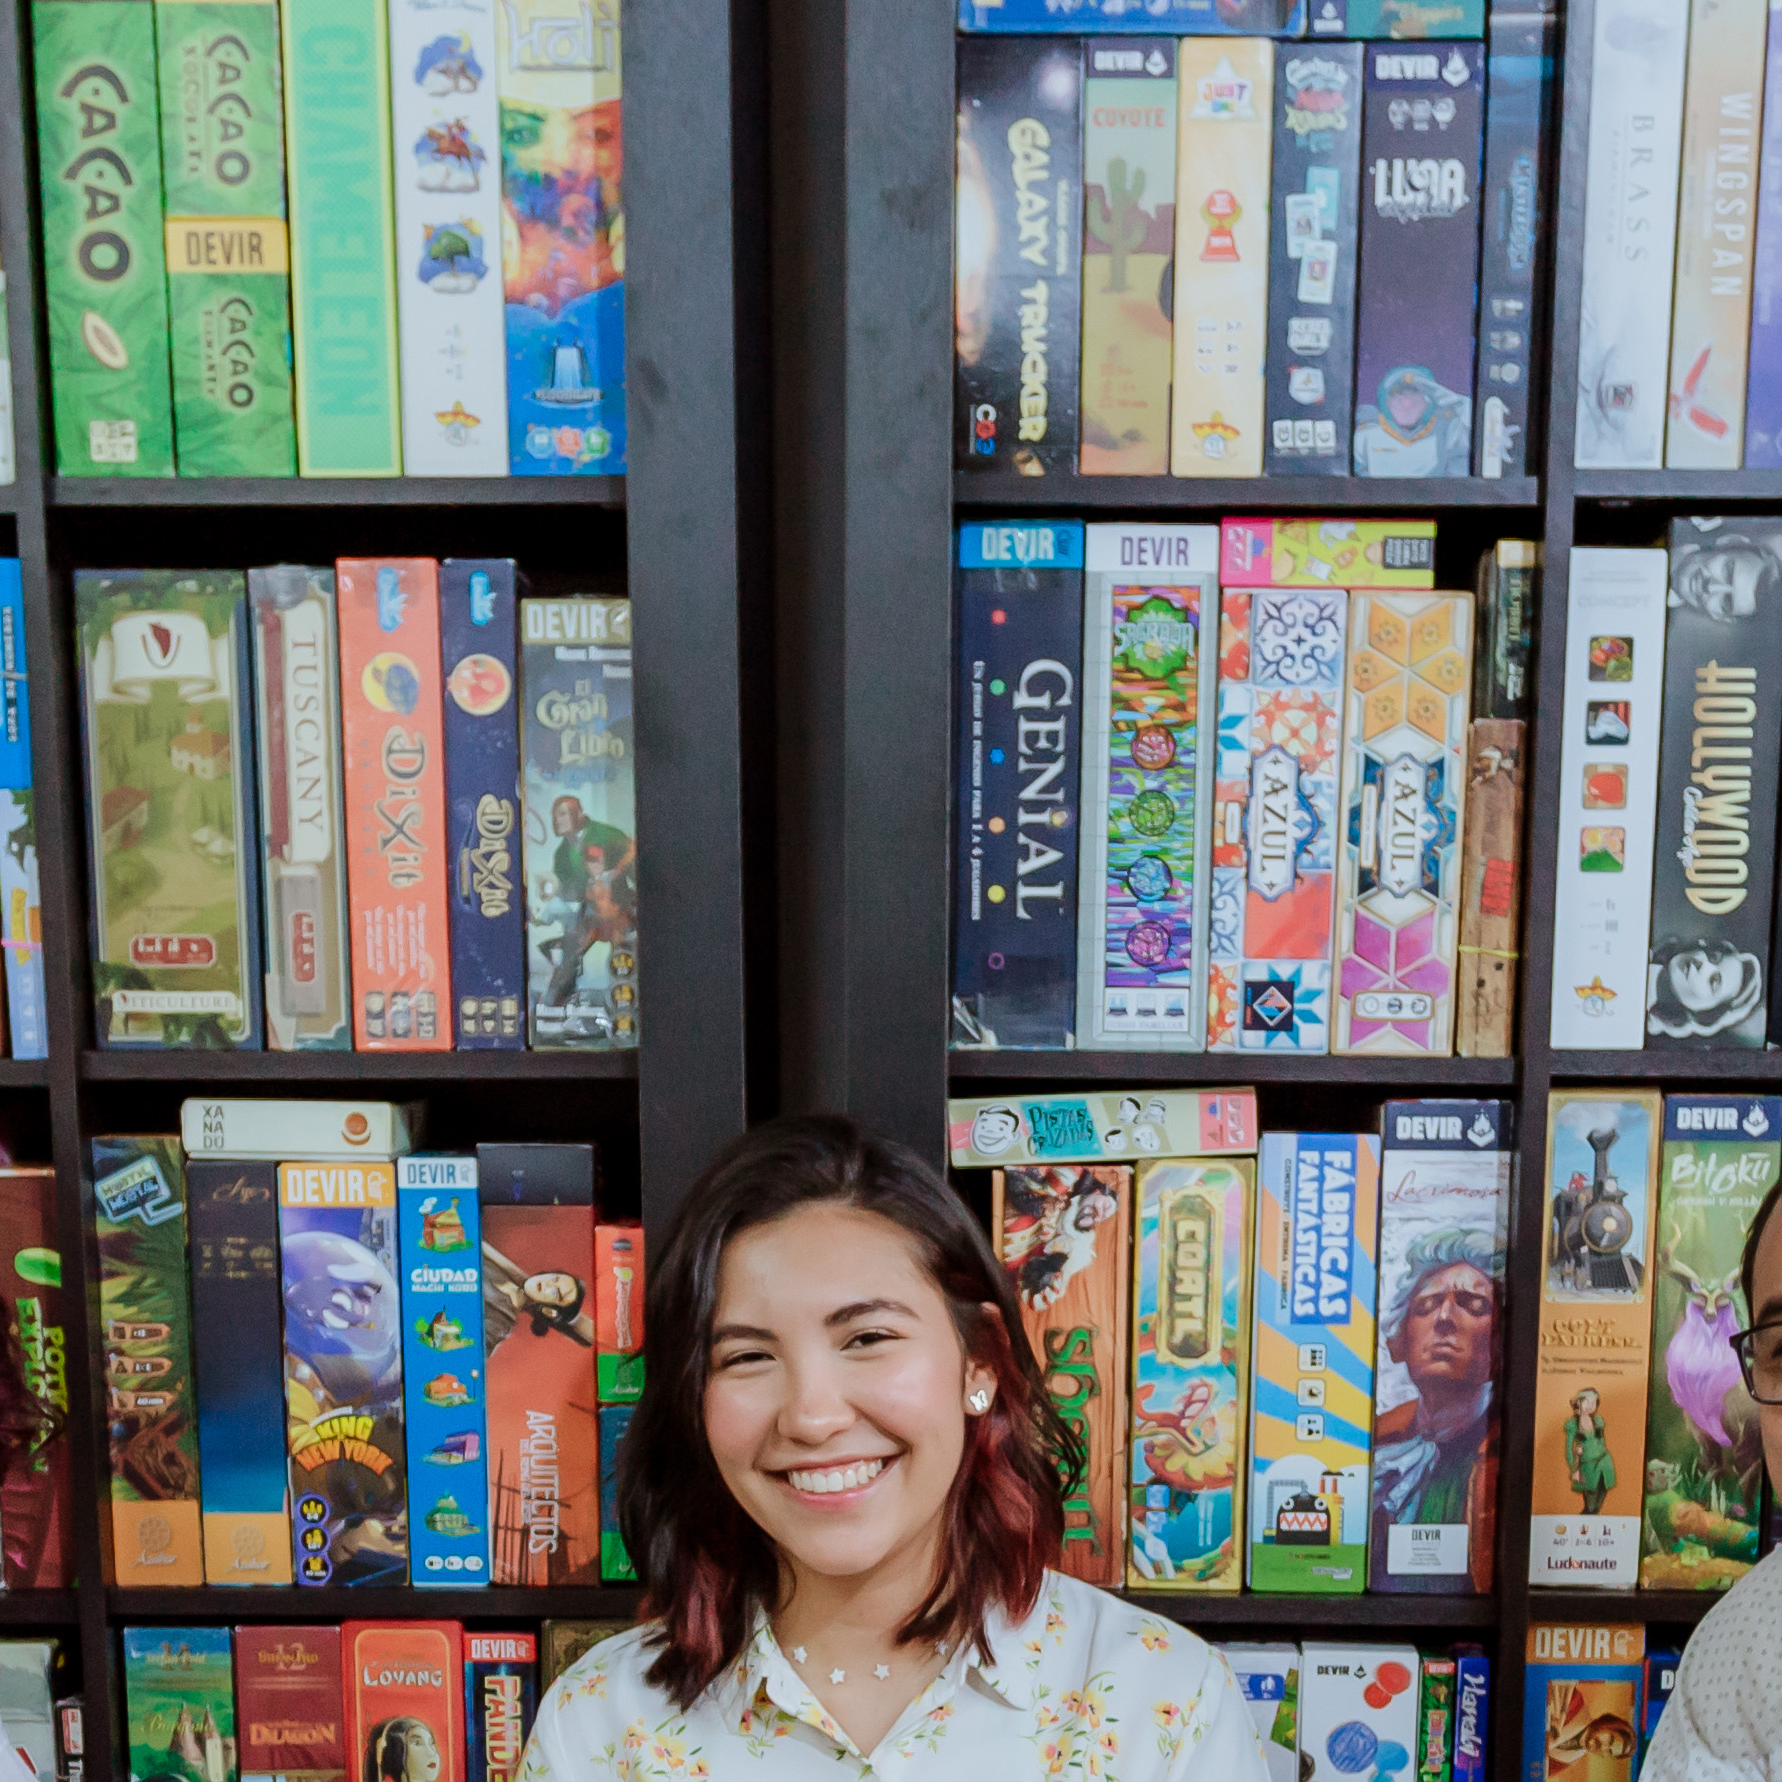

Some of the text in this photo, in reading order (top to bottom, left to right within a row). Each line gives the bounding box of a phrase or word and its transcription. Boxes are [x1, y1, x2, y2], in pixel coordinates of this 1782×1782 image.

[1375, 54, 1439, 80] DEVIR
[206, 34, 252, 186] CACAO
[1092, 107, 1166, 127] COYOTE
[60, 64, 133, 283] CACAO
[1624, 113, 1655, 263] BRASS
[1710, 92, 1754, 297] WINGSPAN
[186, 231, 264, 267] DEVIR
[1007, 117, 1052, 443] GALAXY TRUCKER
[221, 297, 256, 409] CACAO
[982, 528, 1055, 561] DEVIR
[1121, 537, 1189, 566] DEVIR
[527, 604, 605, 640] DEVIR
[291, 634, 325, 834] TUSCANY
[1684, 659, 1758, 916] HOLLYWOOD
[1261, 772, 1289, 874] AZUL
[1390, 778, 1419, 873] AZUL
[202, 1105, 225, 1119] XA
[202, 1120, 225, 1134] NA
[1028, 1106, 1088, 1132] PISTAS
[1396, 1115, 1463, 1140] DEVIR
[1676, 1107, 1739, 1131] DEVIR
[287, 1169, 364, 1202] DEVIR
[407, 1163, 456, 1185] DEVIR
[1293, 1150, 1321, 1317] FANTÁSTICAS
[1319, 1150, 1356, 1320] FÁBRICAS
[315, 1415, 375, 1442] KING
[525, 1409, 560, 1555] ARQUITECTOS
[1412, 1529, 1441, 1541] DEVIR
[1547, 1555, 1618, 1571] Ludonaute
[471, 1638, 516, 1660] DEVIR
[1535, 1627, 1611, 1659] DEVIR
[1316, 1665, 1350, 1676] DEVIR
